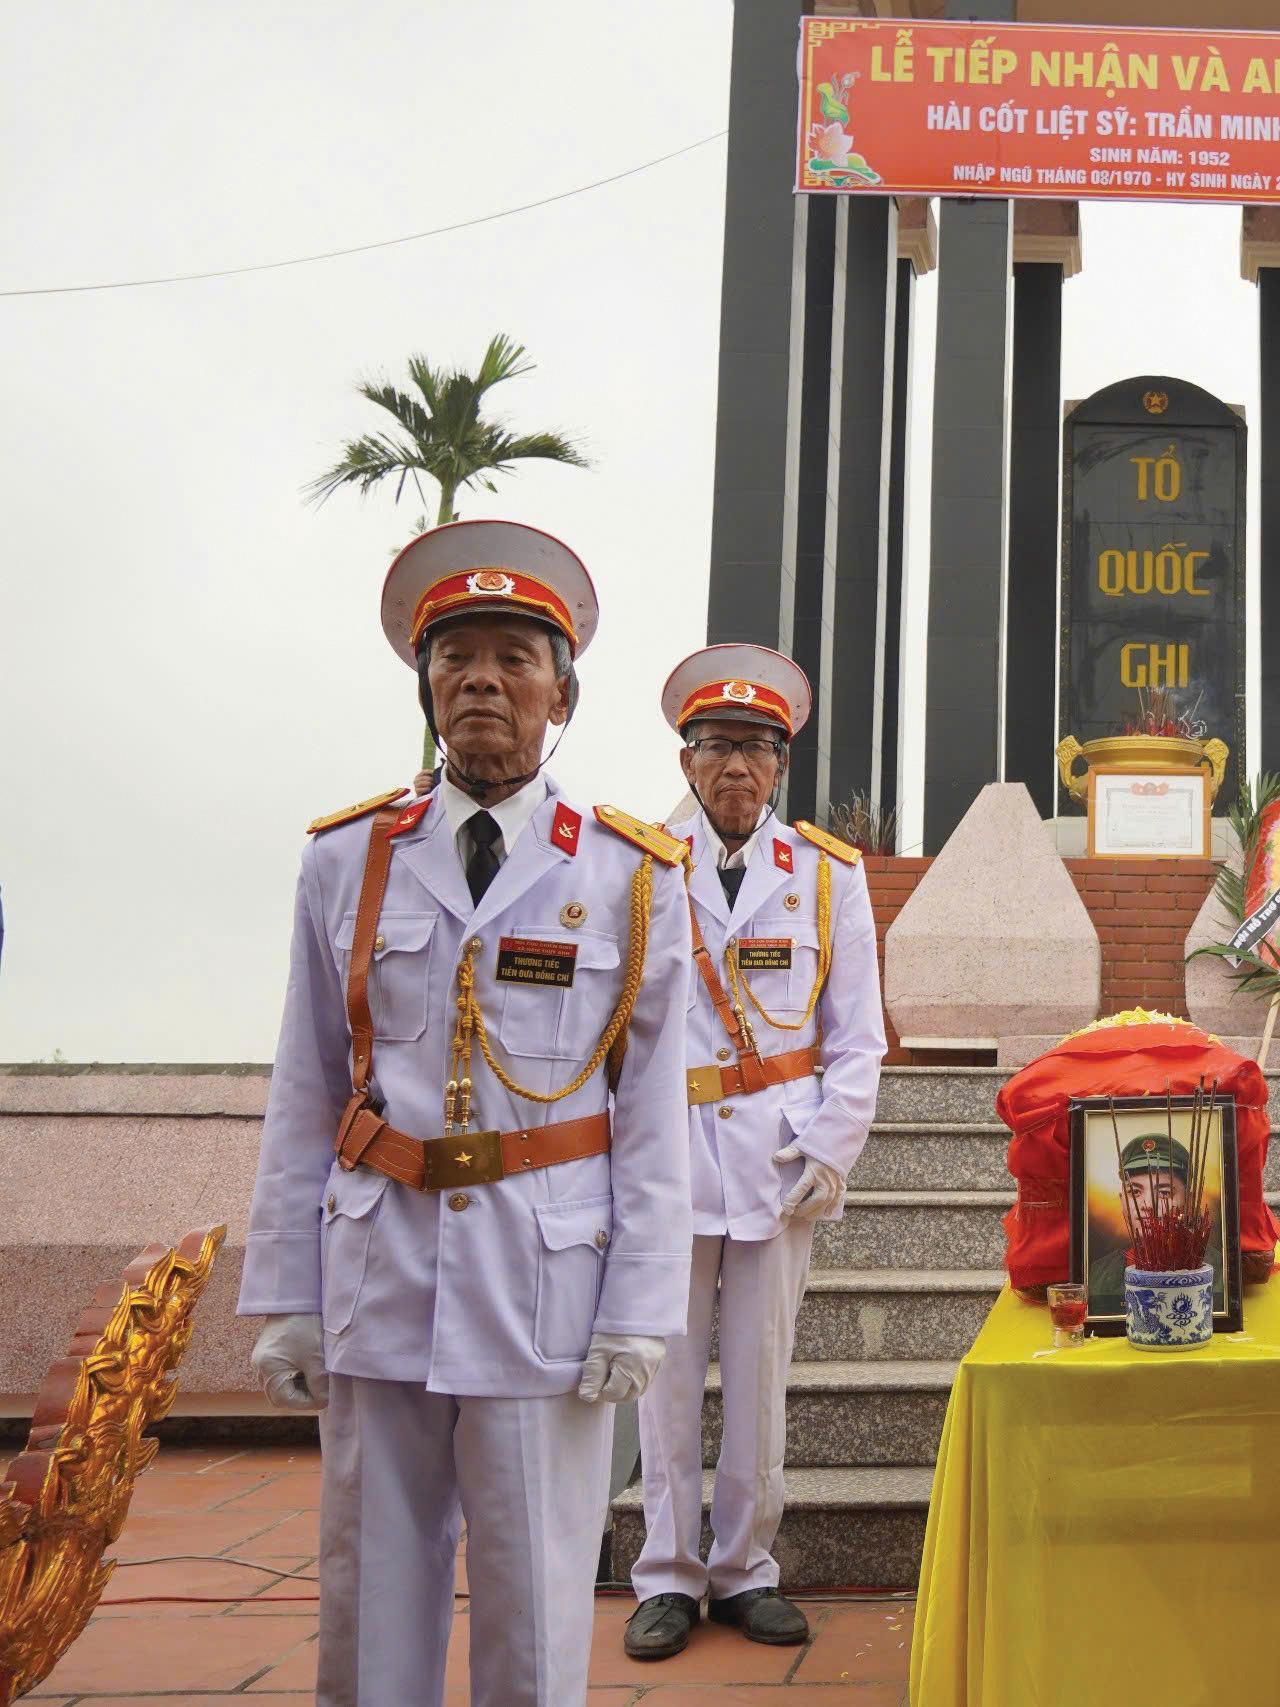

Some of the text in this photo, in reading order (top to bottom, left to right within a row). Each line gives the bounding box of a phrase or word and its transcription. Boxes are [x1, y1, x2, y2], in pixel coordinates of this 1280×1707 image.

[871, 29, 914, 82] LỄ
[926, 36, 1018, 84] TIẾP
[1031, 43, 1158, 98] NHẬN
[1171, 46, 1230, 93] VÀ
[927, 100, 971, 131] HÀI
[979, 99, 1028, 133] CỐT
[1036, 104, 1088, 140] LIỆT
[1096, 106, 1137, 136] SỸ:
[1144, 105, 1212, 139] TRẦN
[954, 163, 996, 184] NHẬP
[1000, 166, 1032, 183] NGŨ
[1037, 166, 1086, 184] THÁNG
[1090, 170, 1151, 186] 08/1970
[1166, 172, 1185, 186] HY
[1190, 173, 1226, 188] SINH
[1231, 173, 1271, 190] NGÀY
[1090, 146, 1230, 166] SINH NĂM: 1952
[1098, 542, 1210, 596] QUỐC
[1120, 643, 1189, 688] GHI
